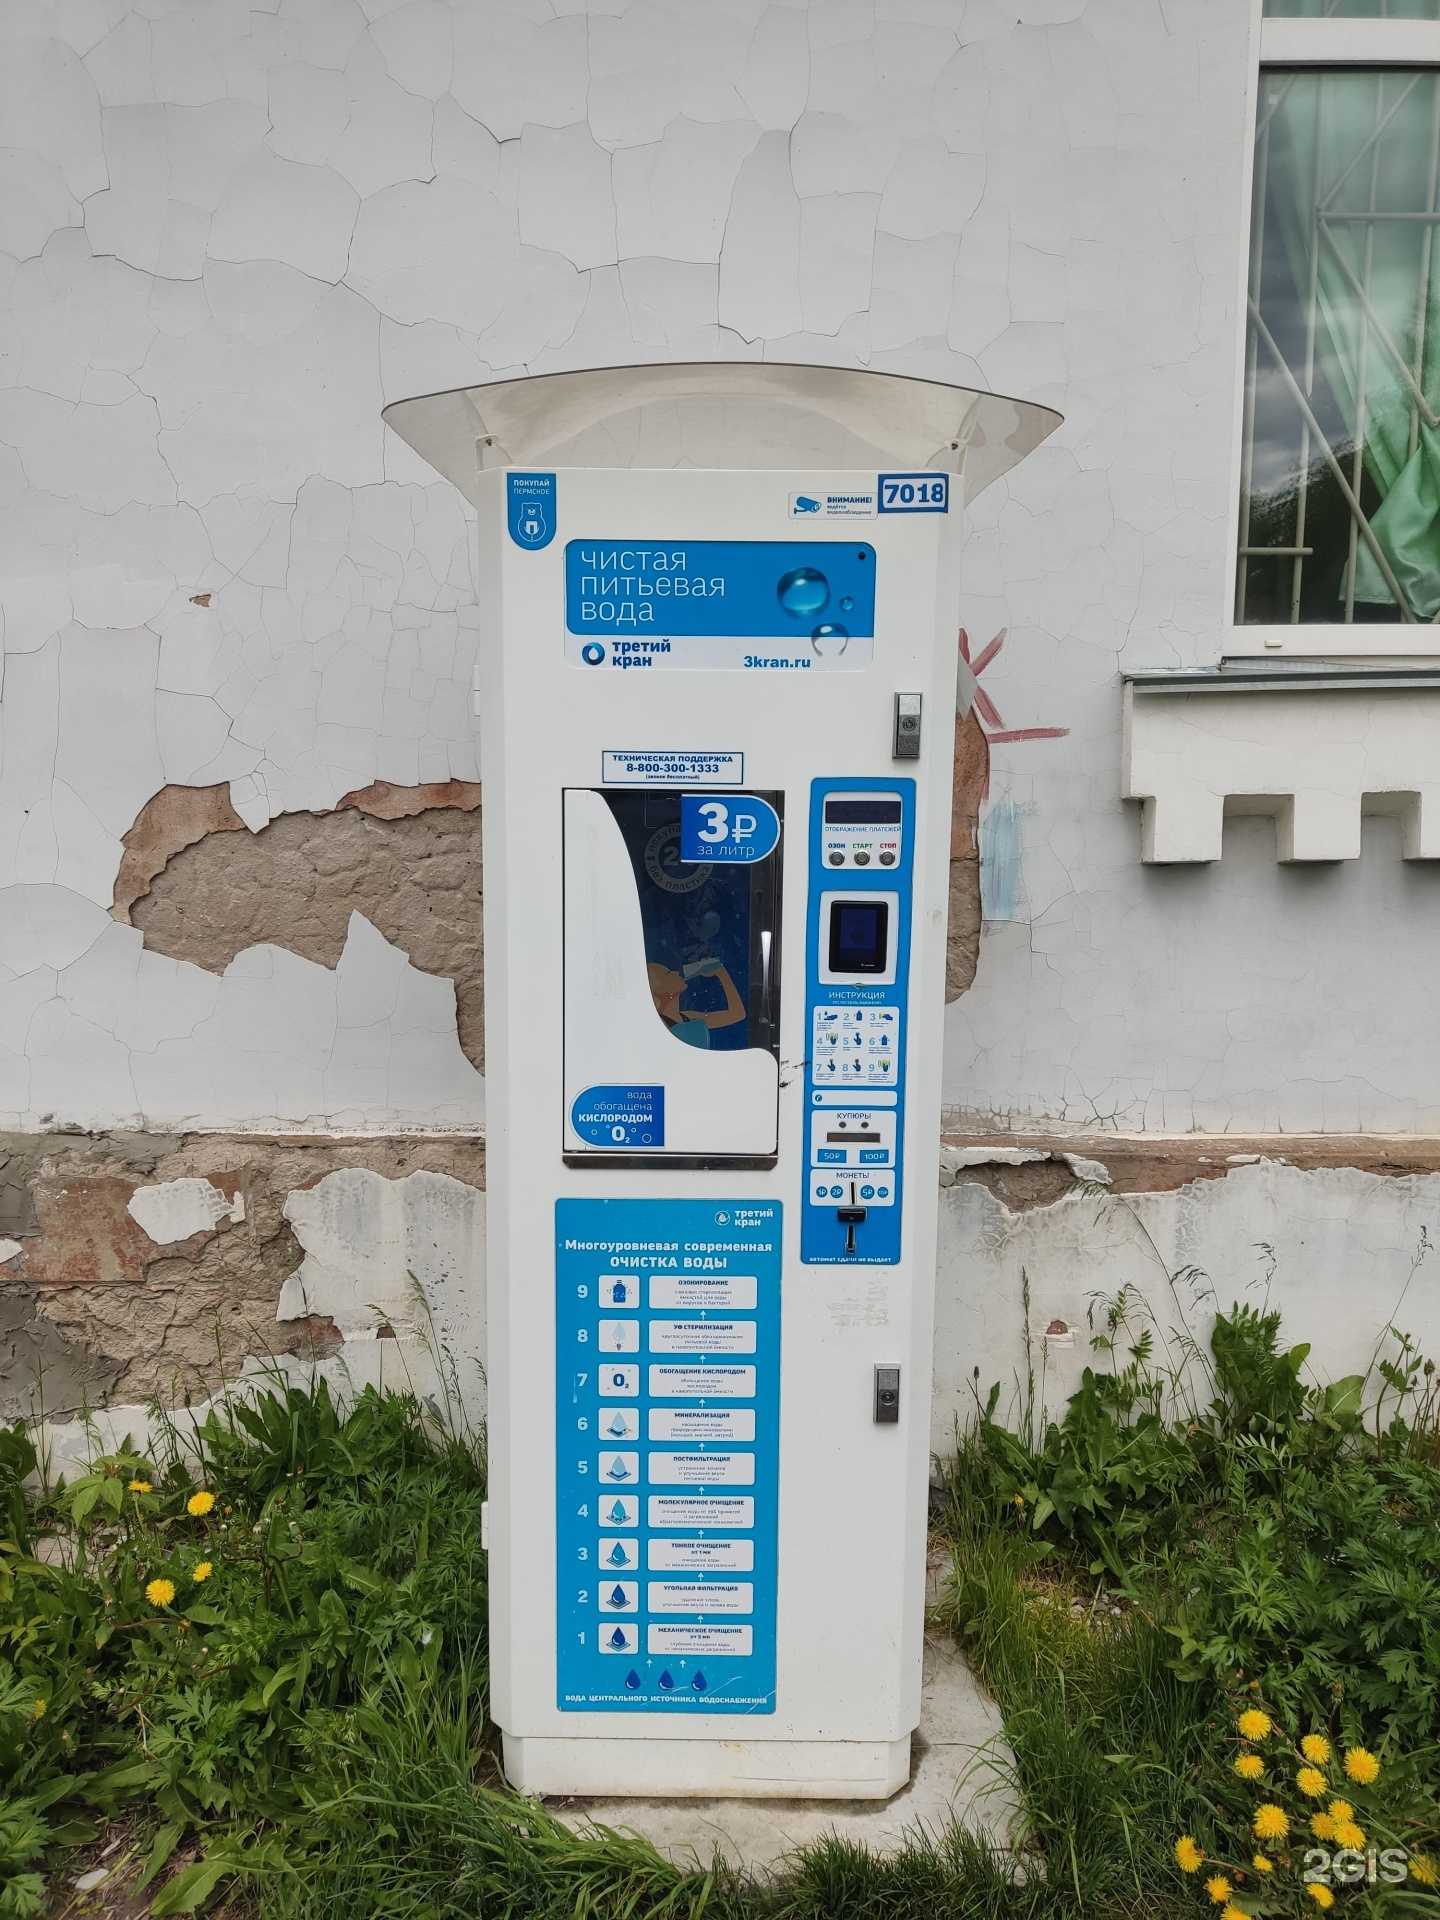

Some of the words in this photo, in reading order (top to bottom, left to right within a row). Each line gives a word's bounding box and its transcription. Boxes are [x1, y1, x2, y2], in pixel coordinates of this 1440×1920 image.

[513, 478, 550, 487] ПОКУПАЙ
[884, 483, 944, 503] 7018
[580, 551, 687, 571] чистая
[580, 575, 726, 598] питьевая
[580, 601, 655, 627] вода
[612, 638, 671, 655] третий
[612, 654, 652, 669] кран
[743, 655, 811, 669] 3kran.ru
[678, 755, 733, 763] ПОДДЕРЖКА
[626, 763, 720, 773] 8-800-300-1333
[697, 846, 713, 855] за
[718, 846, 755, 858] литр
[828, 991, 886, 1000] ИНСТРУКЦИЯ
[627, 1091, 652, 1100] вода
[593, 1101, 652, 1112] обогащена
[578, 1113, 653, 1123] КИСЛОРОДОМ
[735, 1209, 773, 1218] третий
[735, 1218, 761, 1227] кран
[565, 1239, 679, 1253] Многоуровневая
[684, 1243, 773, 1253] современная
[610, 1257, 678, 1268] ОЧИСТКА
[683, 1257, 727, 1270] ВОДЫ
[577, 1284, 588, 1299] 9
[577, 1329, 589, 1343] 8
[577, 1373, 588, 1387] 7
[577, 1417, 589, 1431] 6
[577, 1461, 588, 1474] 5
[577, 1504, 589, 1518] 4
[577, 1547, 588, 1560] 3
[577, 1590, 588, 1603] 2
[578, 1632, 585, 1644] 1
[566, 1695, 586, 1703] ВОДА
[699, 1696, 767, 1704] ВОДОСНАБЖЕНИЯ
